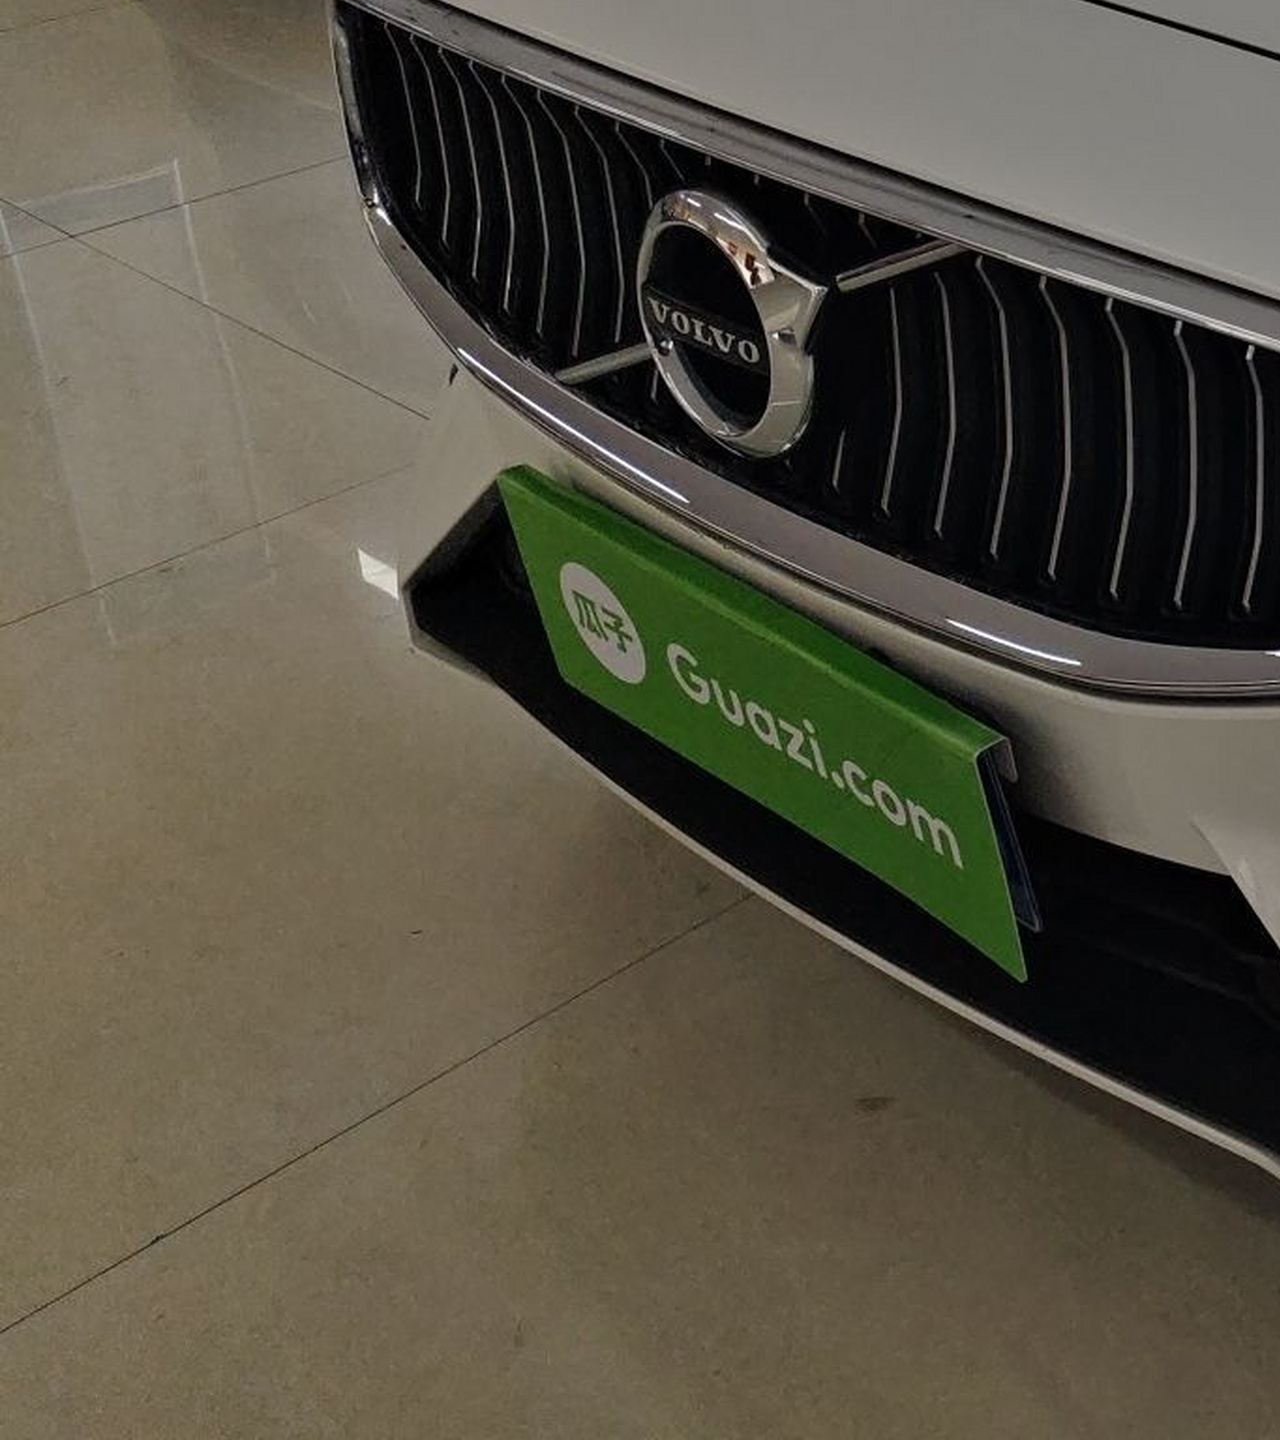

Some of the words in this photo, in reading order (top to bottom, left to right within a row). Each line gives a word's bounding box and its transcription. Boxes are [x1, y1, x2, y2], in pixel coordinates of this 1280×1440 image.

[647, 297, 760, 363] VOLVO
[571, 589, 633, 654] 瓜子
[667, 643, 963, 870] Guazi.com
